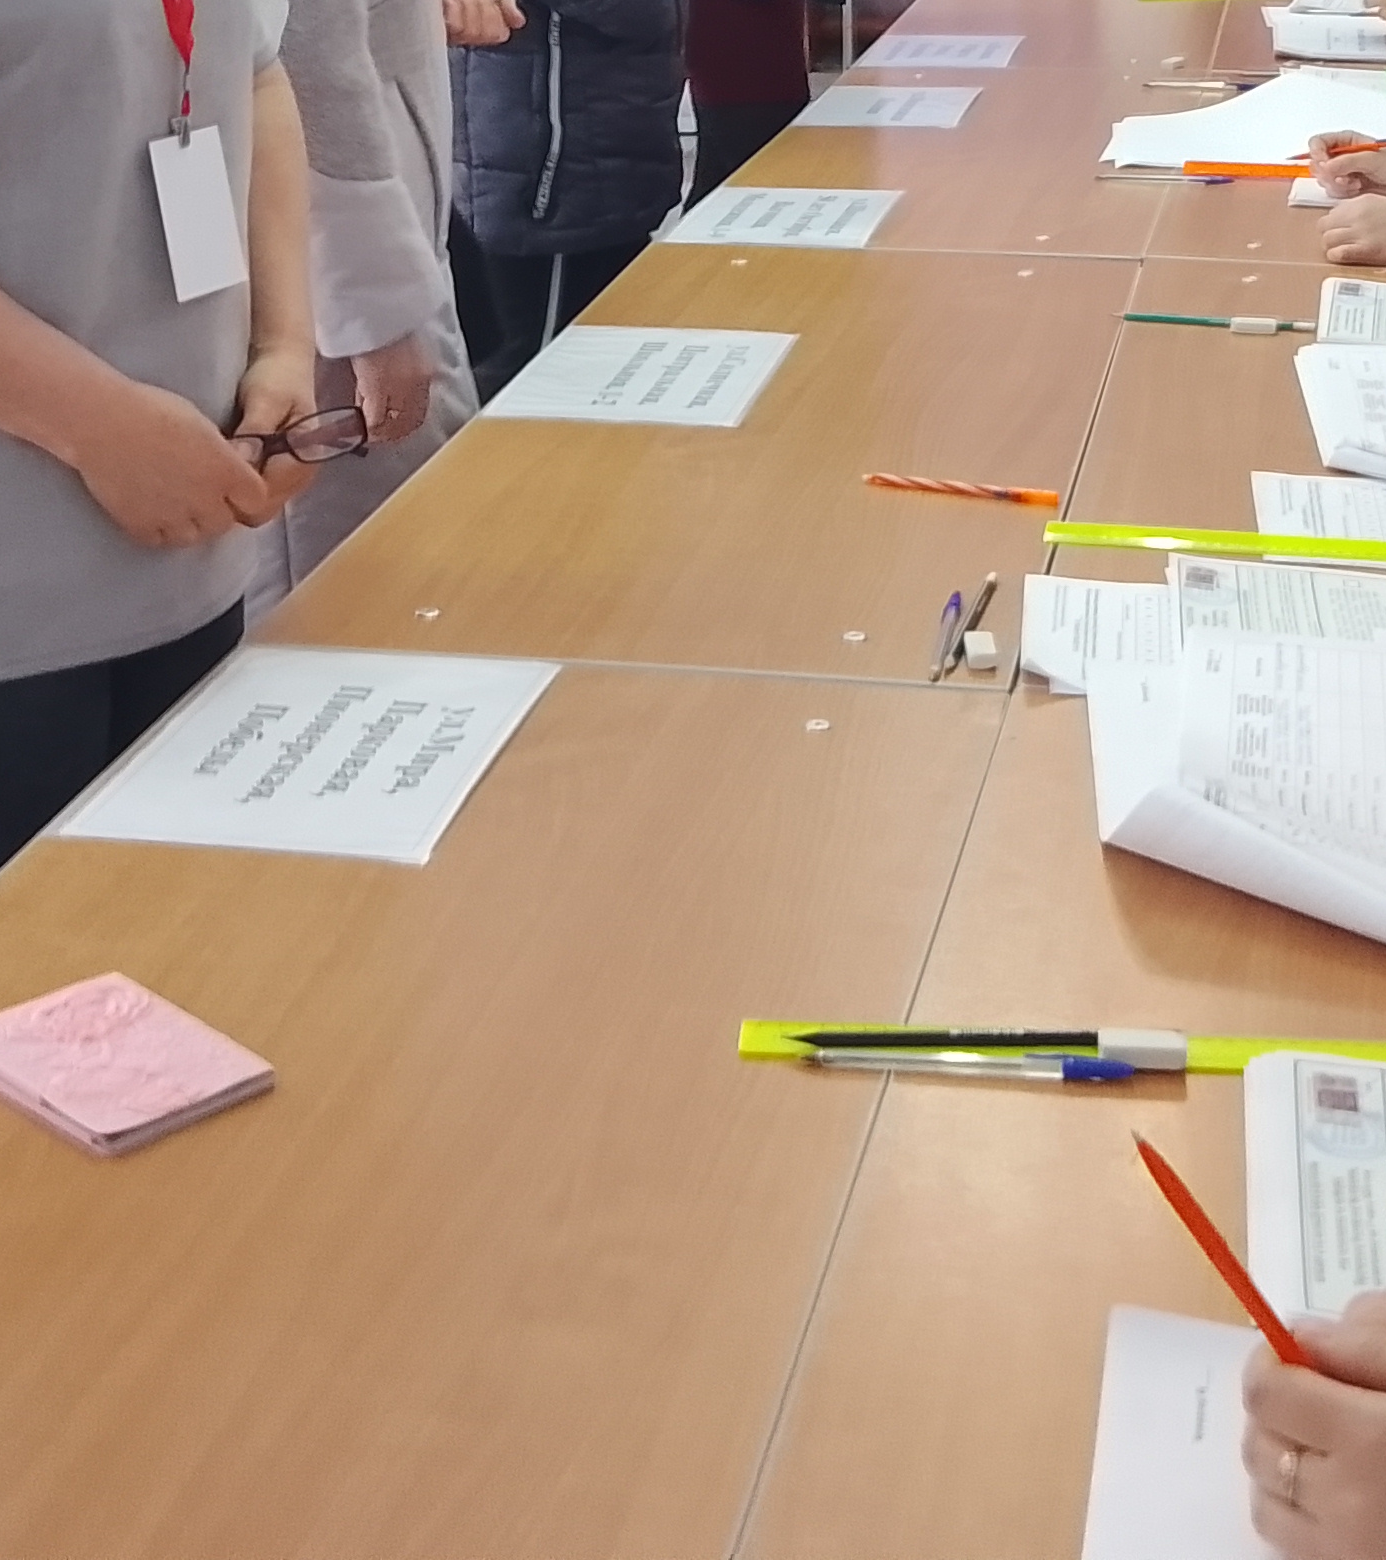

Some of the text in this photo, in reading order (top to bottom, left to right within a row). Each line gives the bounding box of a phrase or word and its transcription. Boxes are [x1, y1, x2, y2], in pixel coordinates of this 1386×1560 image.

[193, 703, 290, 775] Победы
[235, 685, 374, 804] Пионерская,
[312, 699, 429, 798] Парковая,
